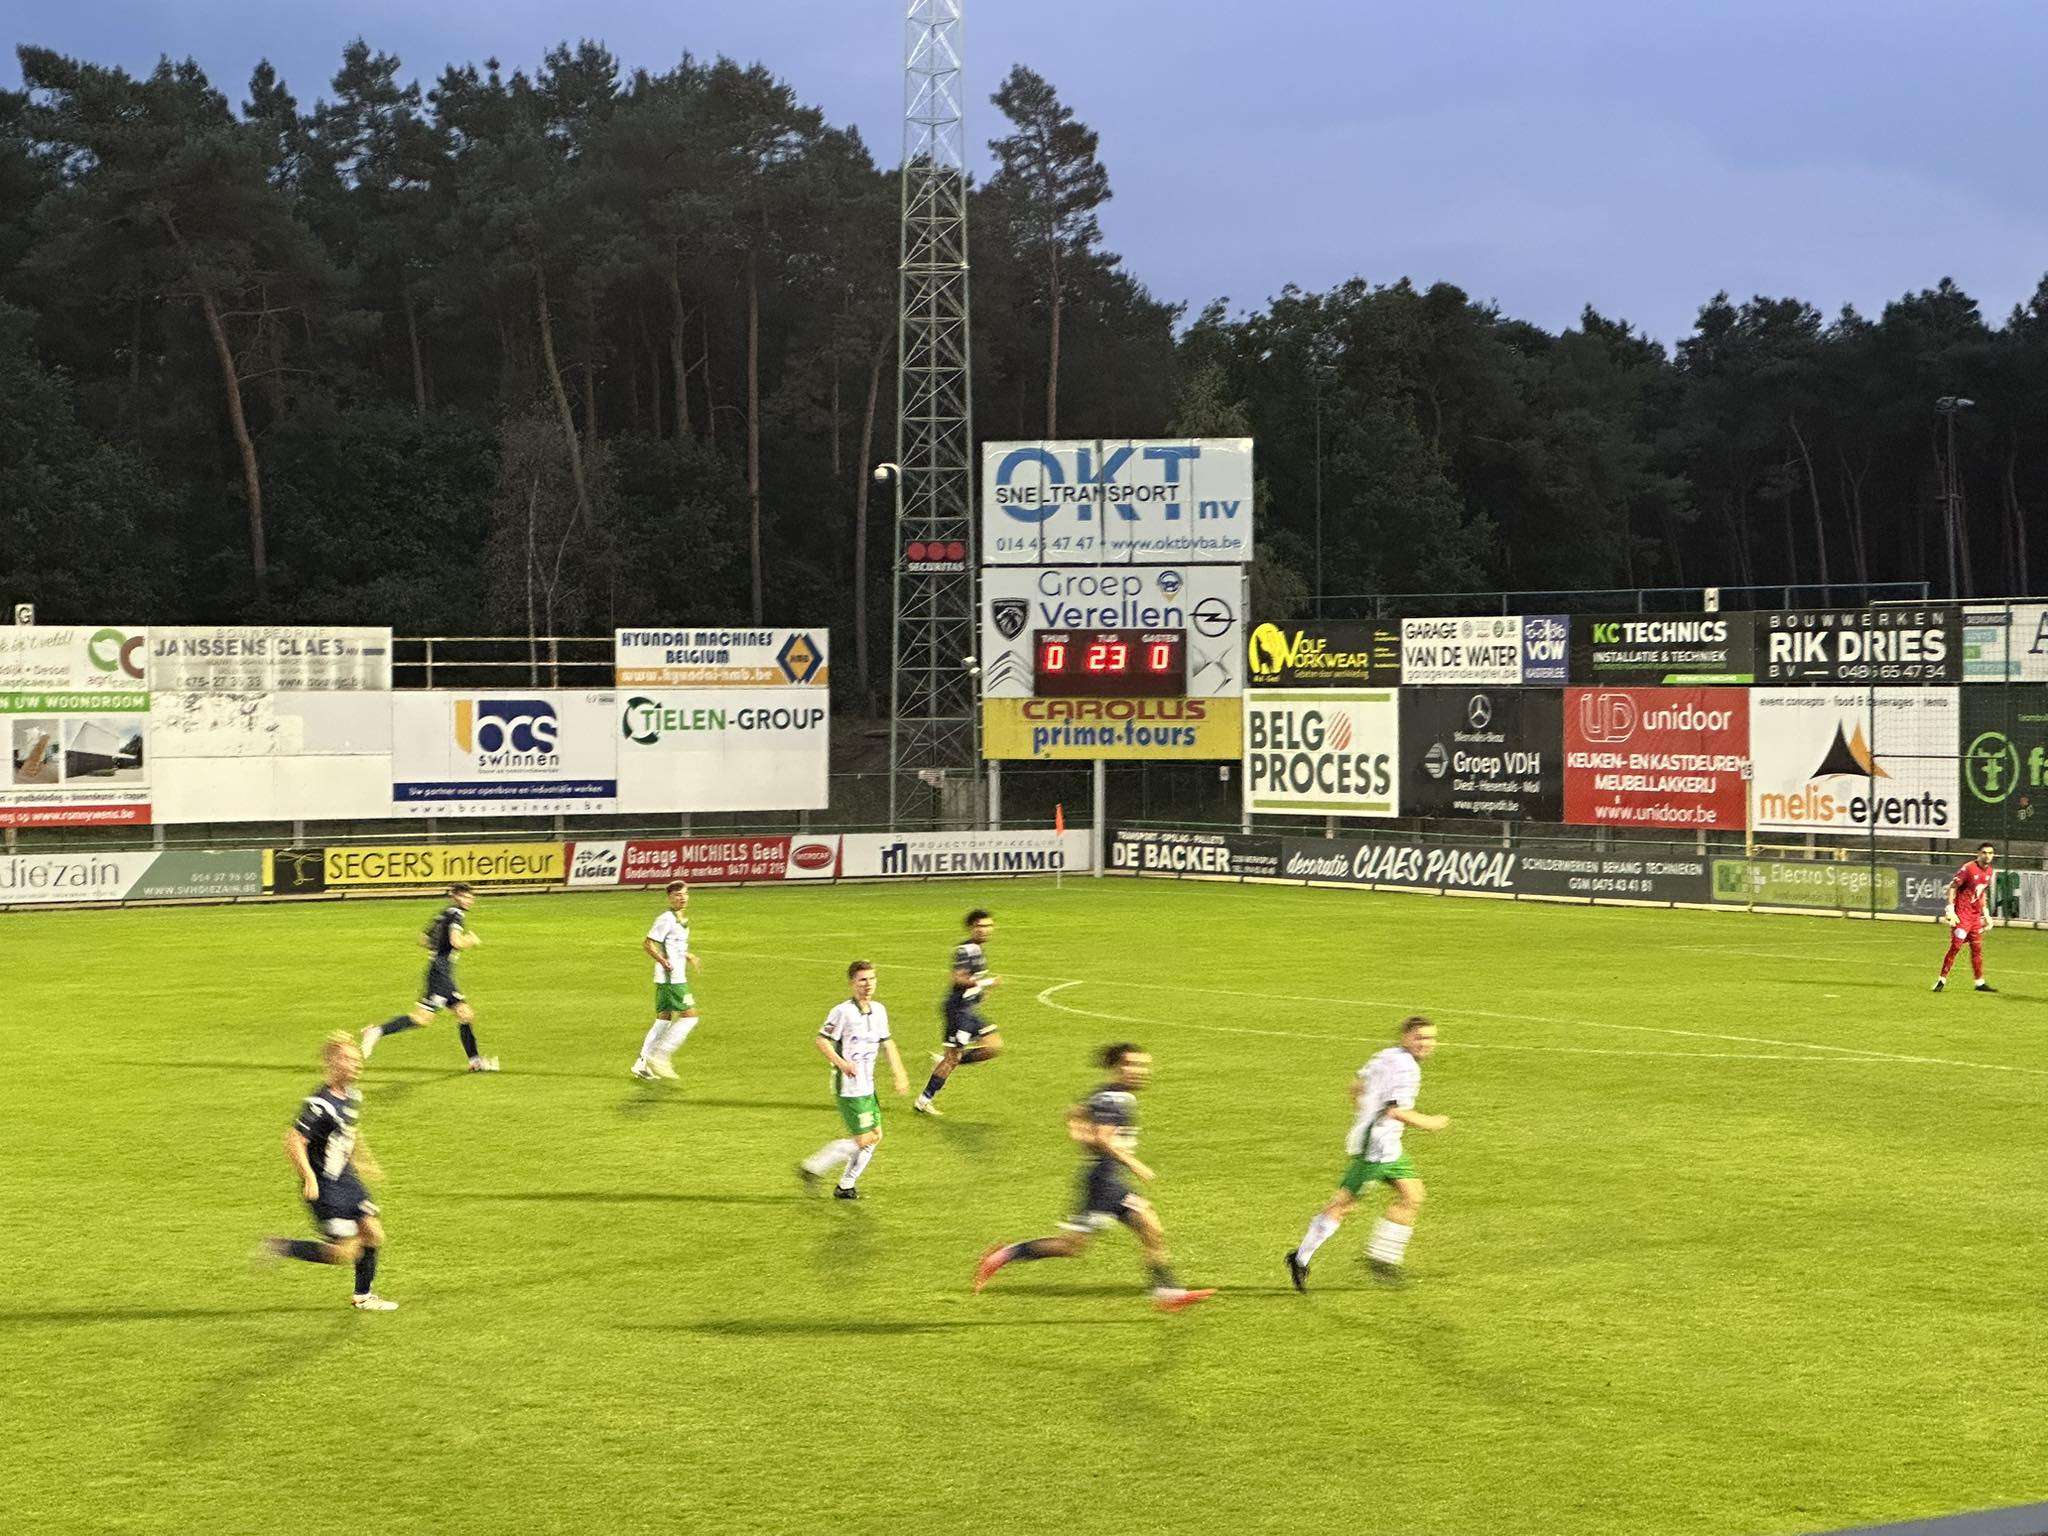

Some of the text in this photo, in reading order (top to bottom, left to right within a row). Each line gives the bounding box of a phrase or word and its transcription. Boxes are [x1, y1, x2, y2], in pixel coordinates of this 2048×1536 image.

[996, 446, 1200, 523] OKT
[996, 485, 1179, 504] SNELTRANSPORT
[1200, 501, 1240, 519] nv
[997, 537, 1023, 550] 014
[1053, 536, 1071, 549] 47
[1075, 536, 1094, 549] 47
[1038, 570, 1143, 600] Groep
[1040, 600, 1183, 628] Verellen
[1769, 611, 1945, 628] BOUWWERKEN
[622, 632, 774, 646] HYUNDAI MACHINES
[1405, 622, 1458, 640] GARAGE
[154, 639, 266, 656] JANSSENS
[1405, 646, 1437, 667] VAN
[1442, 646, 1461, 667] DE
[1466, 645, 1518, 667] WATER
[1526, 641, 1566, 660] VOW
[1592, 650, 1658, 662] INSTALLATIE
[1675, 649, 1728, 662] TECHNIEK
[1769, 629, 1947, 663] RIK DRIES
[666, 650, 730, 664] BELGIUM
[1047, 645, 1169, 670] 0 23 0
[1902, 665, 1922, 678] 47
[1925, 665, 1947, 678] 34
[641, 707, 824, 731] TIELEN-GROUP
[1022, 700, 1206, 720] CAROLUS
[1643, 703, 1732, 731] unidoor
[478, 751, 559, 767] swinnen
[1454, 751, 1540, 778] Groep VDH
[1629, 754, 1648, 769] EN
[1250, 752, 1391, 795] PROCESS
[1594, 774, 1717, 793] MEUBELLAKKERIJ
[1594, 803, 1717, 823] www.unidoor.be
[329, 849, 554, 879] SEGERS interieur
[627, 843, 784, 868] Garage MICHIELS Geel
[911, 850, 1064, 873] MERMIMMO
[1112, 842, 1232, 873] DE BACKER
[1286, 844, 1517, 887] decoratie CLAES PASCAL
